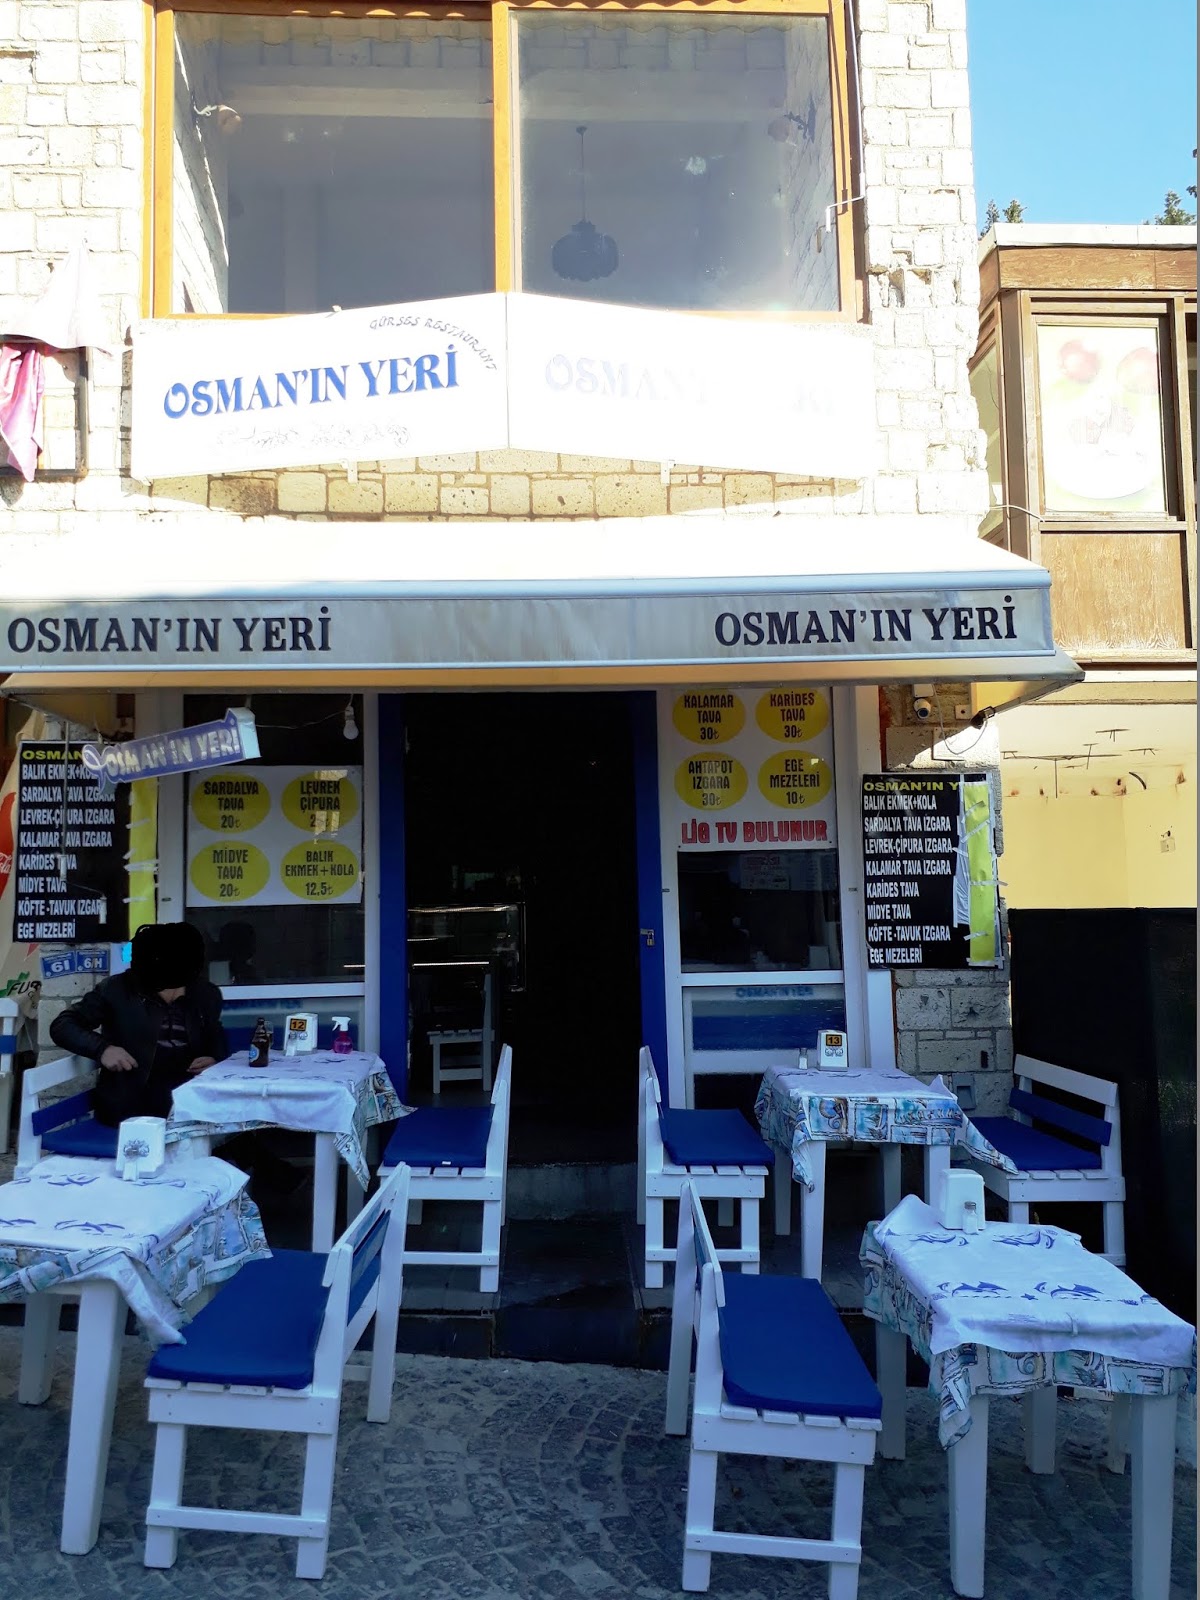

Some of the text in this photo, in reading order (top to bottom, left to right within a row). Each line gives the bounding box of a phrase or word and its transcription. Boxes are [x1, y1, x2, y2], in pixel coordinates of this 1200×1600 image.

[424, 318, 498, 371] RESTAURANT
[163, 344, 460, 419] OSMAN'IN YERİ
[713, 595, 1018, 647] OSMAN'IN YERİ
[7, 606, 333, 653] OSMAN'IN YERİ
[684, 694, 734, 708] KALAMAR
[770, 691, 815, 707] KARİDES
[697, 710, 722, 723] TAVA
[780, 708, 806, 722] TAVA
[22, 764, 46, 779] BALIK
[688, 760, 733, 774] AHTAPOT
[785, 759, 803, 772] EGE
[300, 780, 340, 794] LEVREK
[693, 775, 730, 789] IZGARA
[770, 771, 820, 788] MEZELERİ
[864, 782, 943, 791] OSMAN'IN
[22, 786, 62, 802] SARDALYA
[204, 781, 259, 795] SARDALYA
[218, 798, 244, 810] TAVA
[864, 795, 885, 810] BALIK
[85, 808, 115, 824] IZGARA
[864, 816, 951, 832] SARDALYA TAVA IZGARA
[20, 831, 60, 847] KALAMAR
[82, 831, 112, 847] IZGARA
[715, 822, 737, 843] TV
[743, 820, 827, 843] BULUNUR
[924, 838, 952, 853] IZGARA
[19, 851, 77, 870] KARİDES TVA
[213, 847, 248, 863] MİDYE
[306, 851, 333, 862] BALIK
[217, 866, 243, 879] TAVA
[866, 860, 952, 875] KALAMAR TAVA IZGARA
[18, 873, 44, 892] MİDYE
[866, 879, 920, 898] KARİDES TAVA
[18, 897, 45, 916] KÖFTE
[867, 902, 912, 920] MİDYE TAVA
[18, 918, 76, 939] EGE MEZELERİ
[868, 924, 892, 942] KÖFTE
[922, 926, 951, 941] IZGARA
[870, 944, 922, 963] EGE MEZELERİ
[292, 1020, 305, 1030] 12
[828, 1036, 841, 1045] 13
